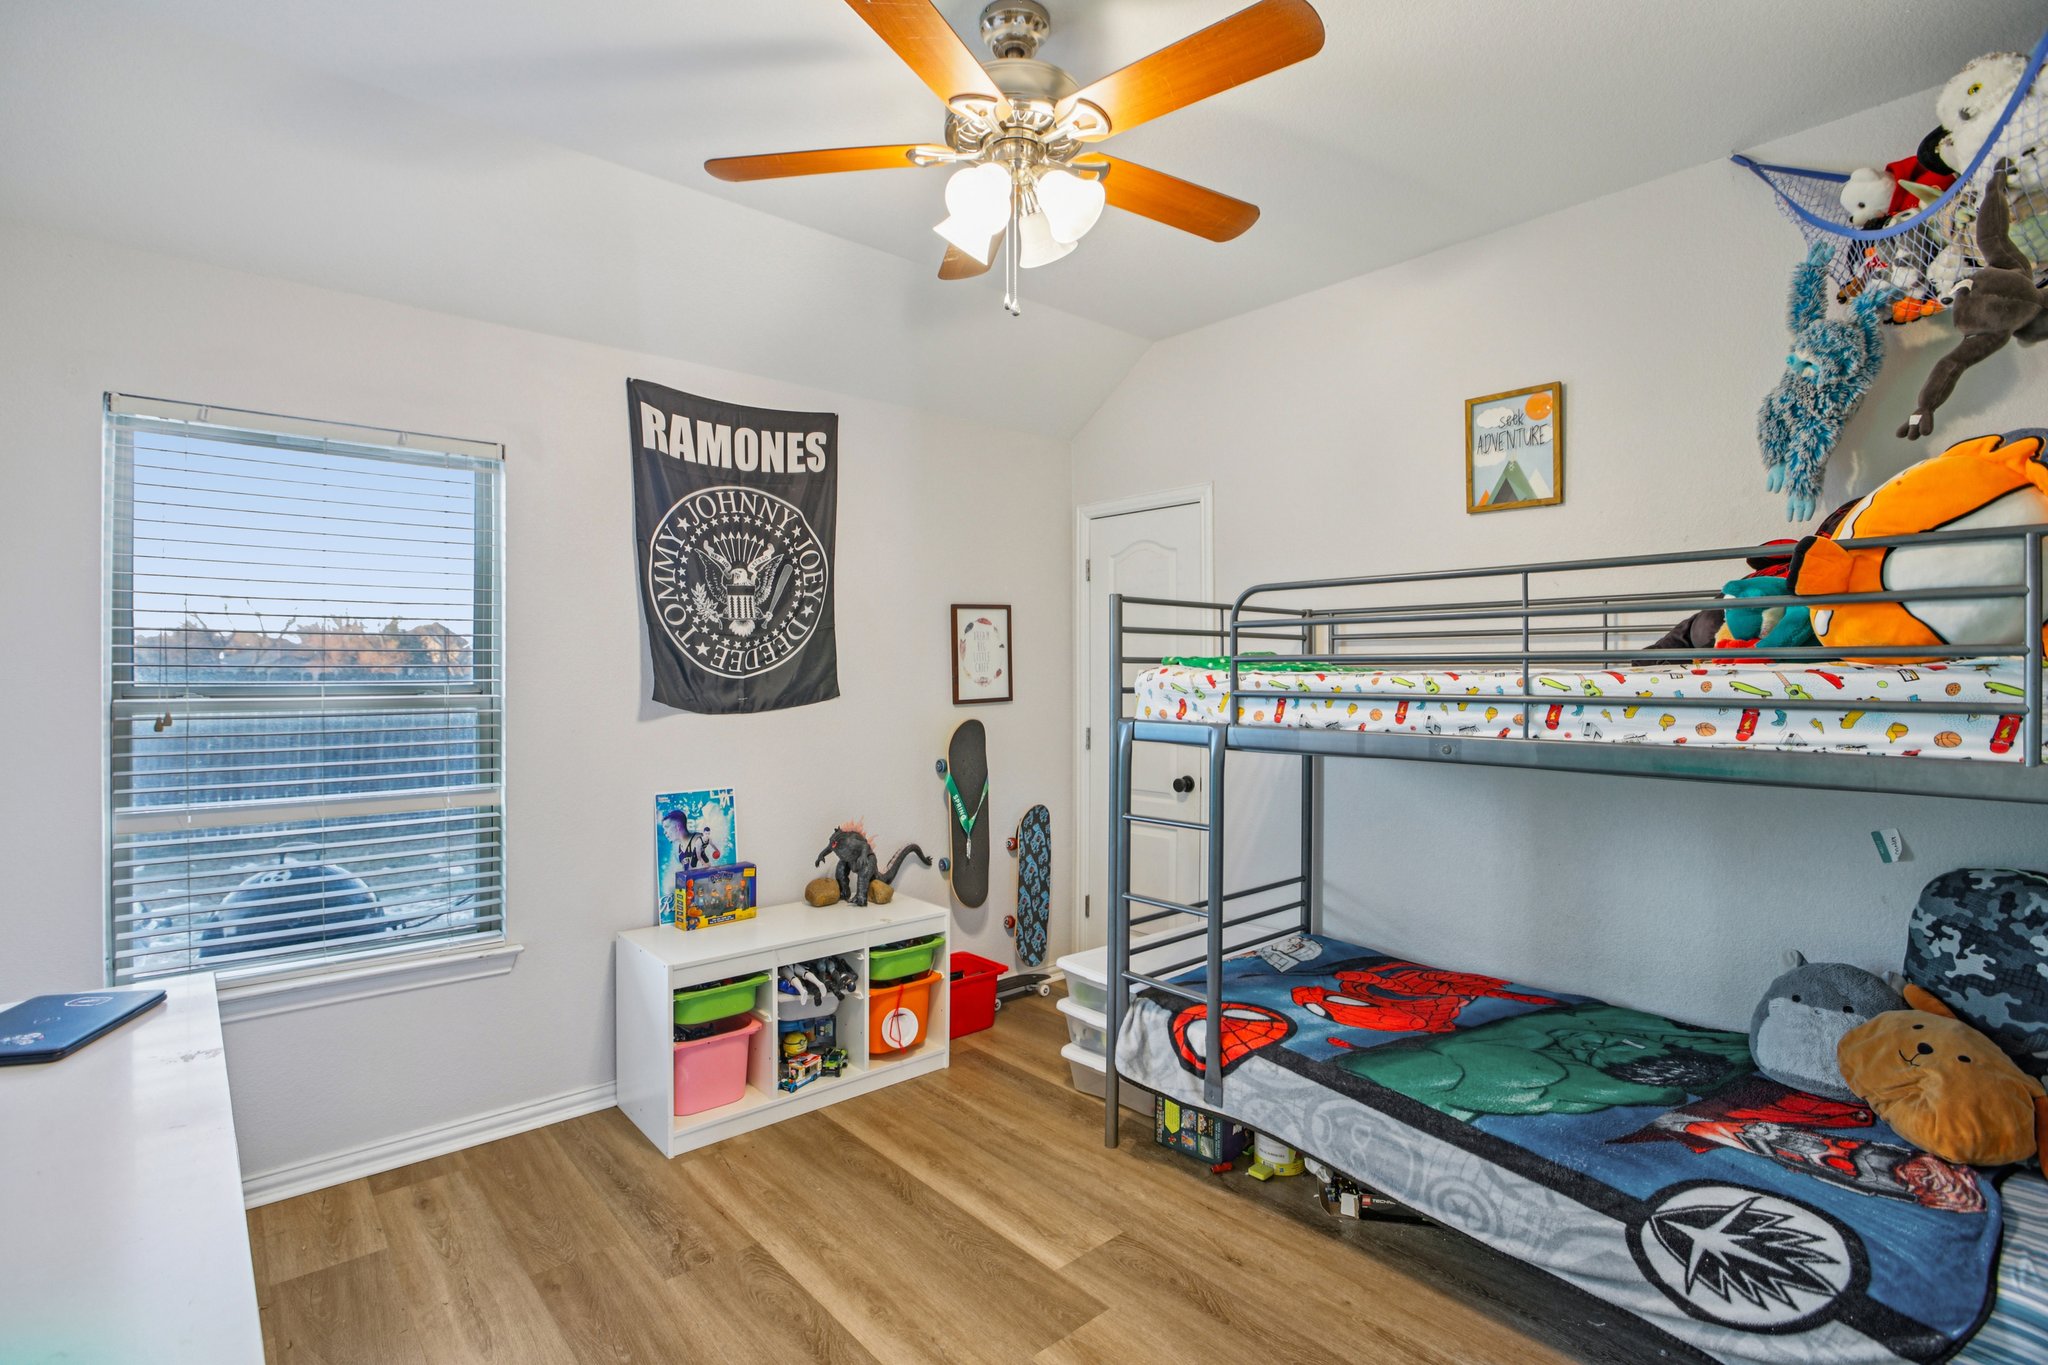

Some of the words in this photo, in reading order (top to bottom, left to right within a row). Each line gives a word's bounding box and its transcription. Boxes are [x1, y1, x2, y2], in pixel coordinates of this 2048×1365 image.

[640, 401, 827, 474] RAMONES
[1477, 423, 1548, 455] ADVENTURE
[1499, 408, 1525, 428] seek
[684, 490, 798, 534] JOHNNY
[654, 523, 691, 650] TOMMY
[794, 537, 824, 603] JOEY
